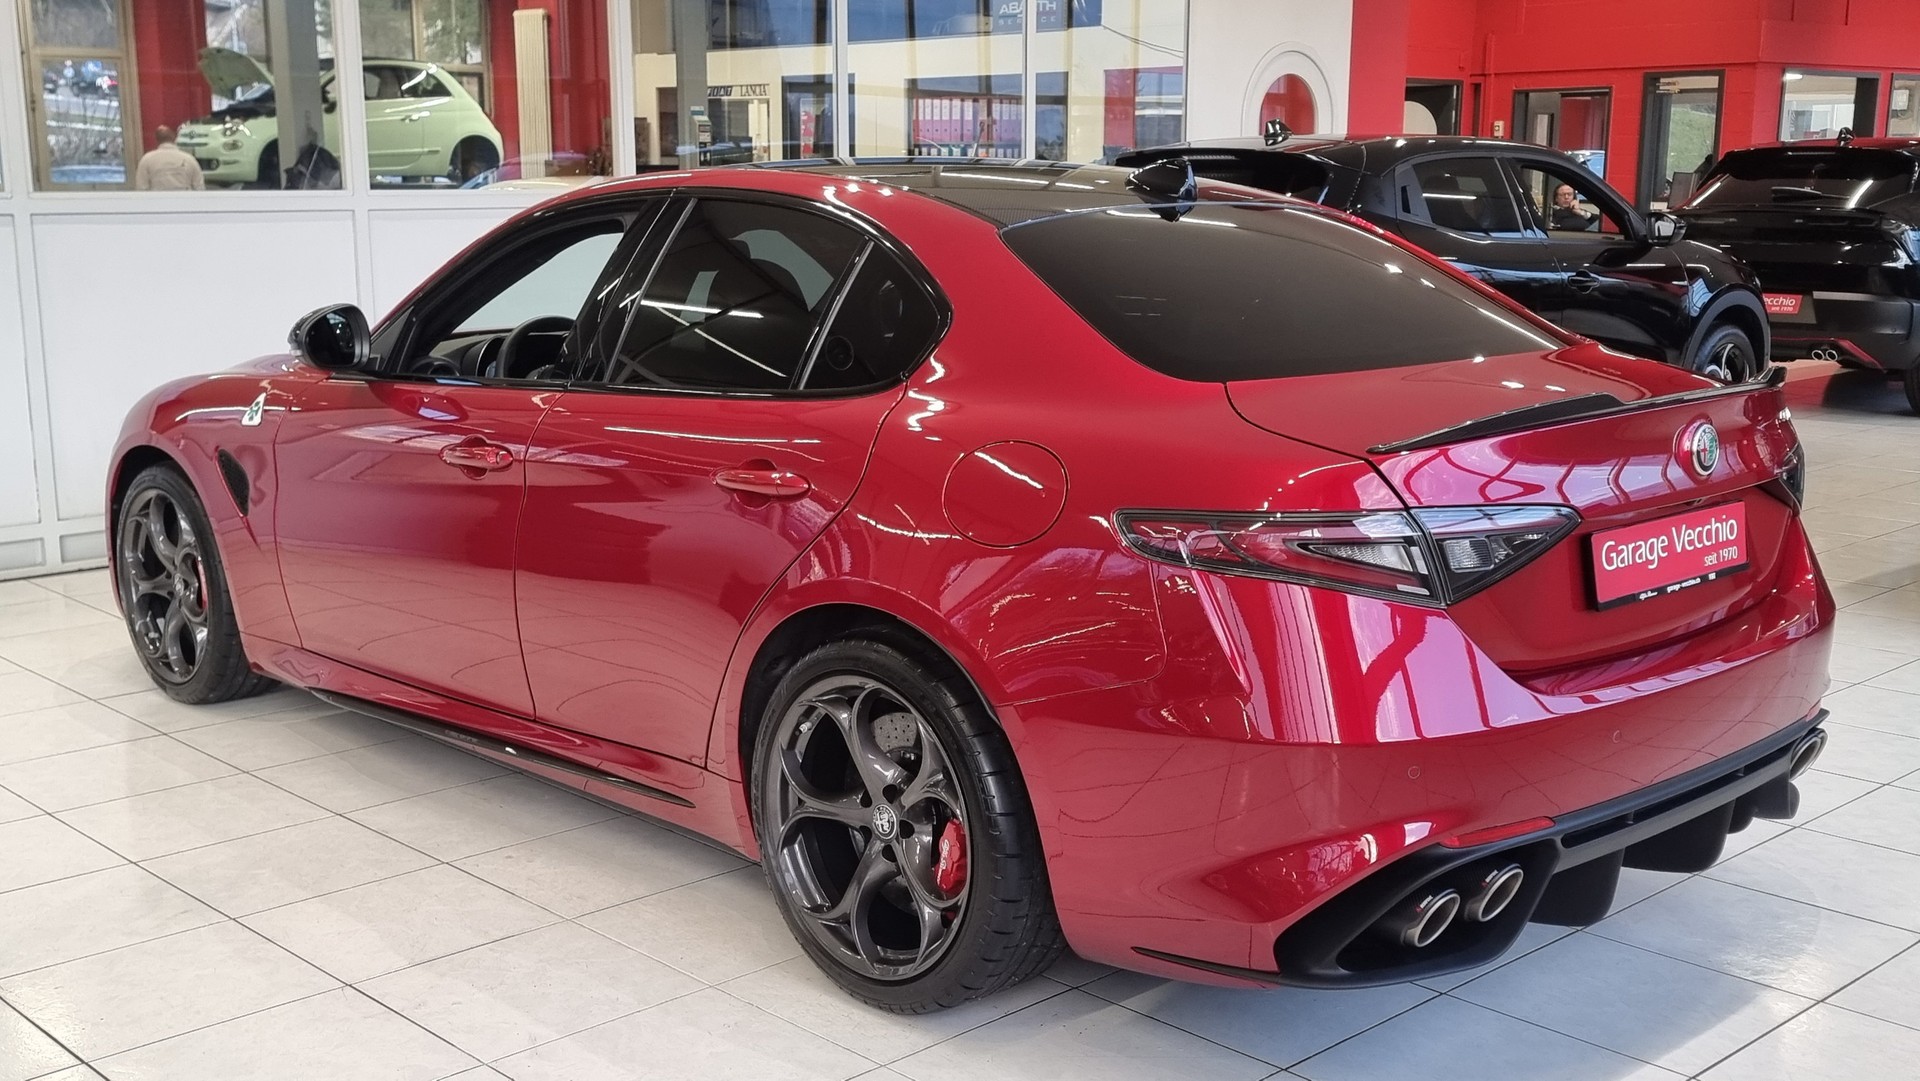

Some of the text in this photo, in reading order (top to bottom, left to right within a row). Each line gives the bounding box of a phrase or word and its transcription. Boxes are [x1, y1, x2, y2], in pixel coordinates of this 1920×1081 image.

[999, 0, 1057, 15] ABTH
[998, 16, 1057, 25] SERCE
[1763, 295, 1796, 306] ecchio
[1602, 514, 1738, 571] Garage Vecchio
[1704, 546, 1738, 567] seit 1970
